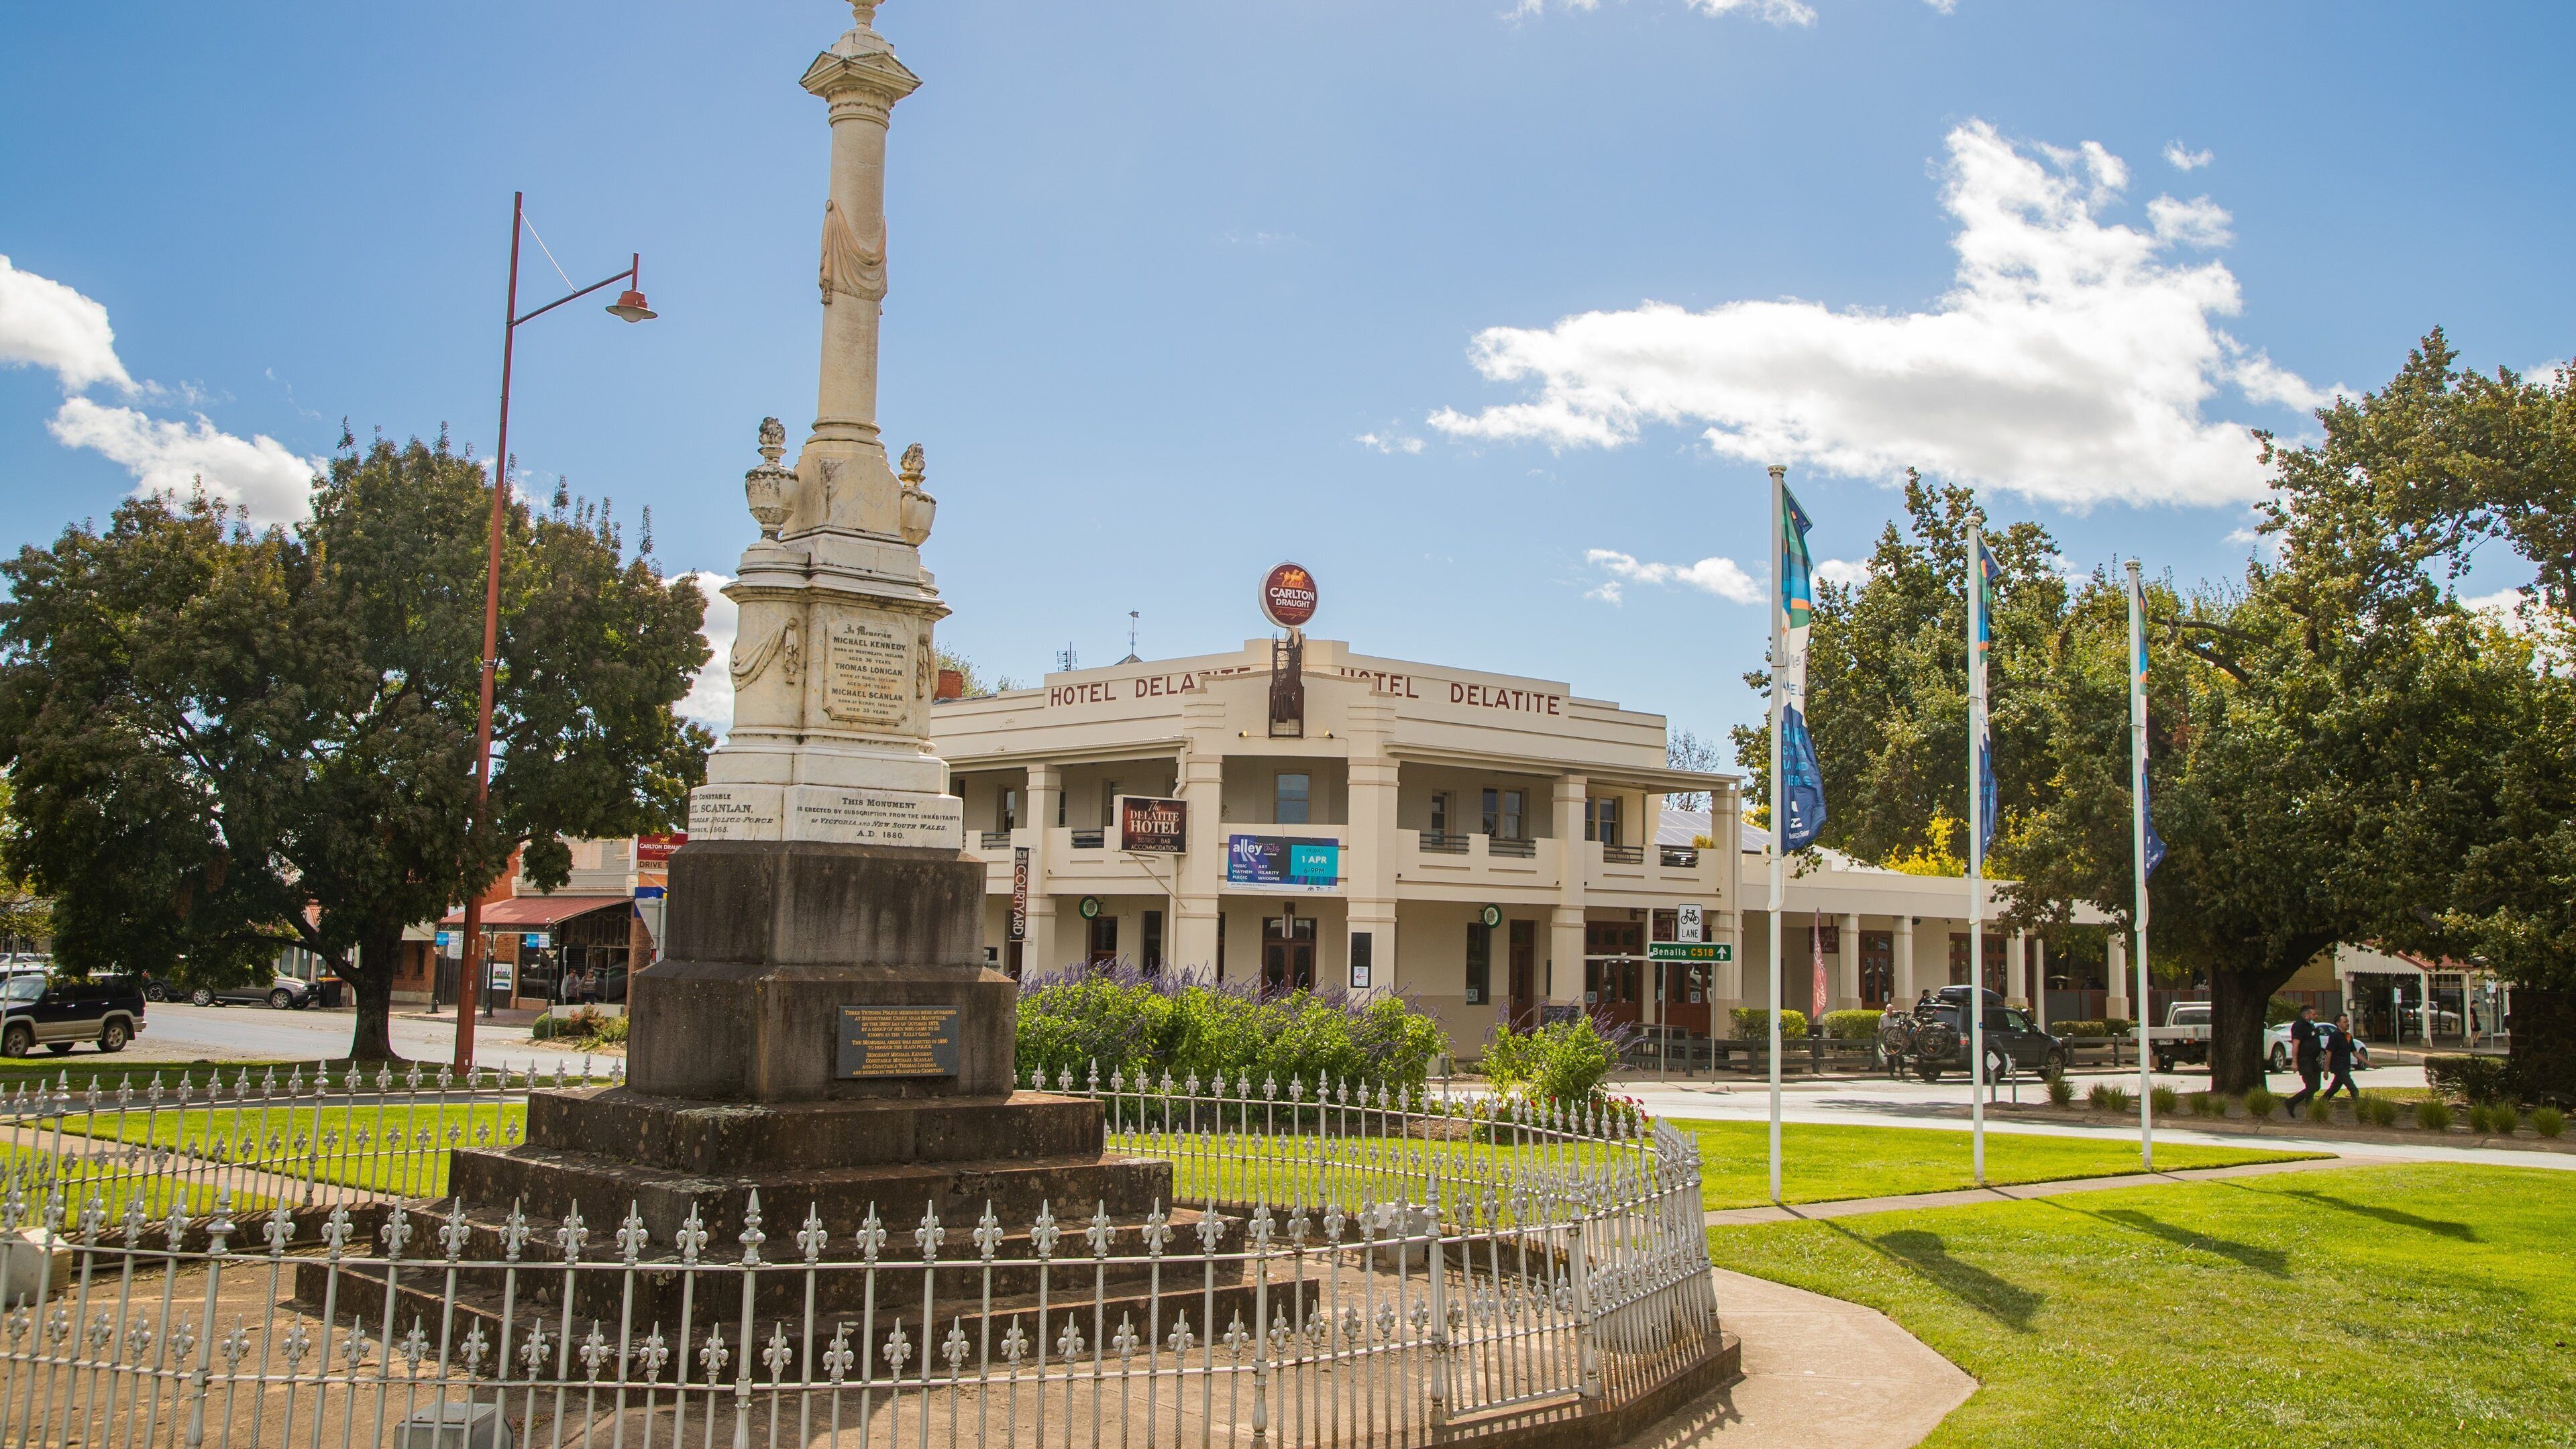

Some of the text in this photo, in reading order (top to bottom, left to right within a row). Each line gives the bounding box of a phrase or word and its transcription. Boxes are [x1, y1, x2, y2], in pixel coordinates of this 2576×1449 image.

[1270, 588, 1314, 600] CARLTON
[1276, 598, 1310, 608] DRAUGHT
[833, 637, 867, 646] MICHAEL
[835, 663, 867, 672] THOMAS
[1051, 667, 1250, 706] HOTEL DELA
[832, 688, 866, 698] MICHAEL
[1450, 683, 1560, 715] DELATITE
[867, 799, 916, 809] MONUMENT
[1148, 800, 1161, 812] The
[1130, 810, 1179, 821] DELATITE
[820, 818, 856, 826] VICTORIA
[1130, 820, 1179, 835] HOTEL
[1233, 839, 1281, 856] alley arts
[1016, 850, 1028, 859] NEW
[1013, 865, 1026, 935] COURTYARD
[1682, 929, 1698, 938] LANE
[1652, 947, 1714, 957] Benalla C518
